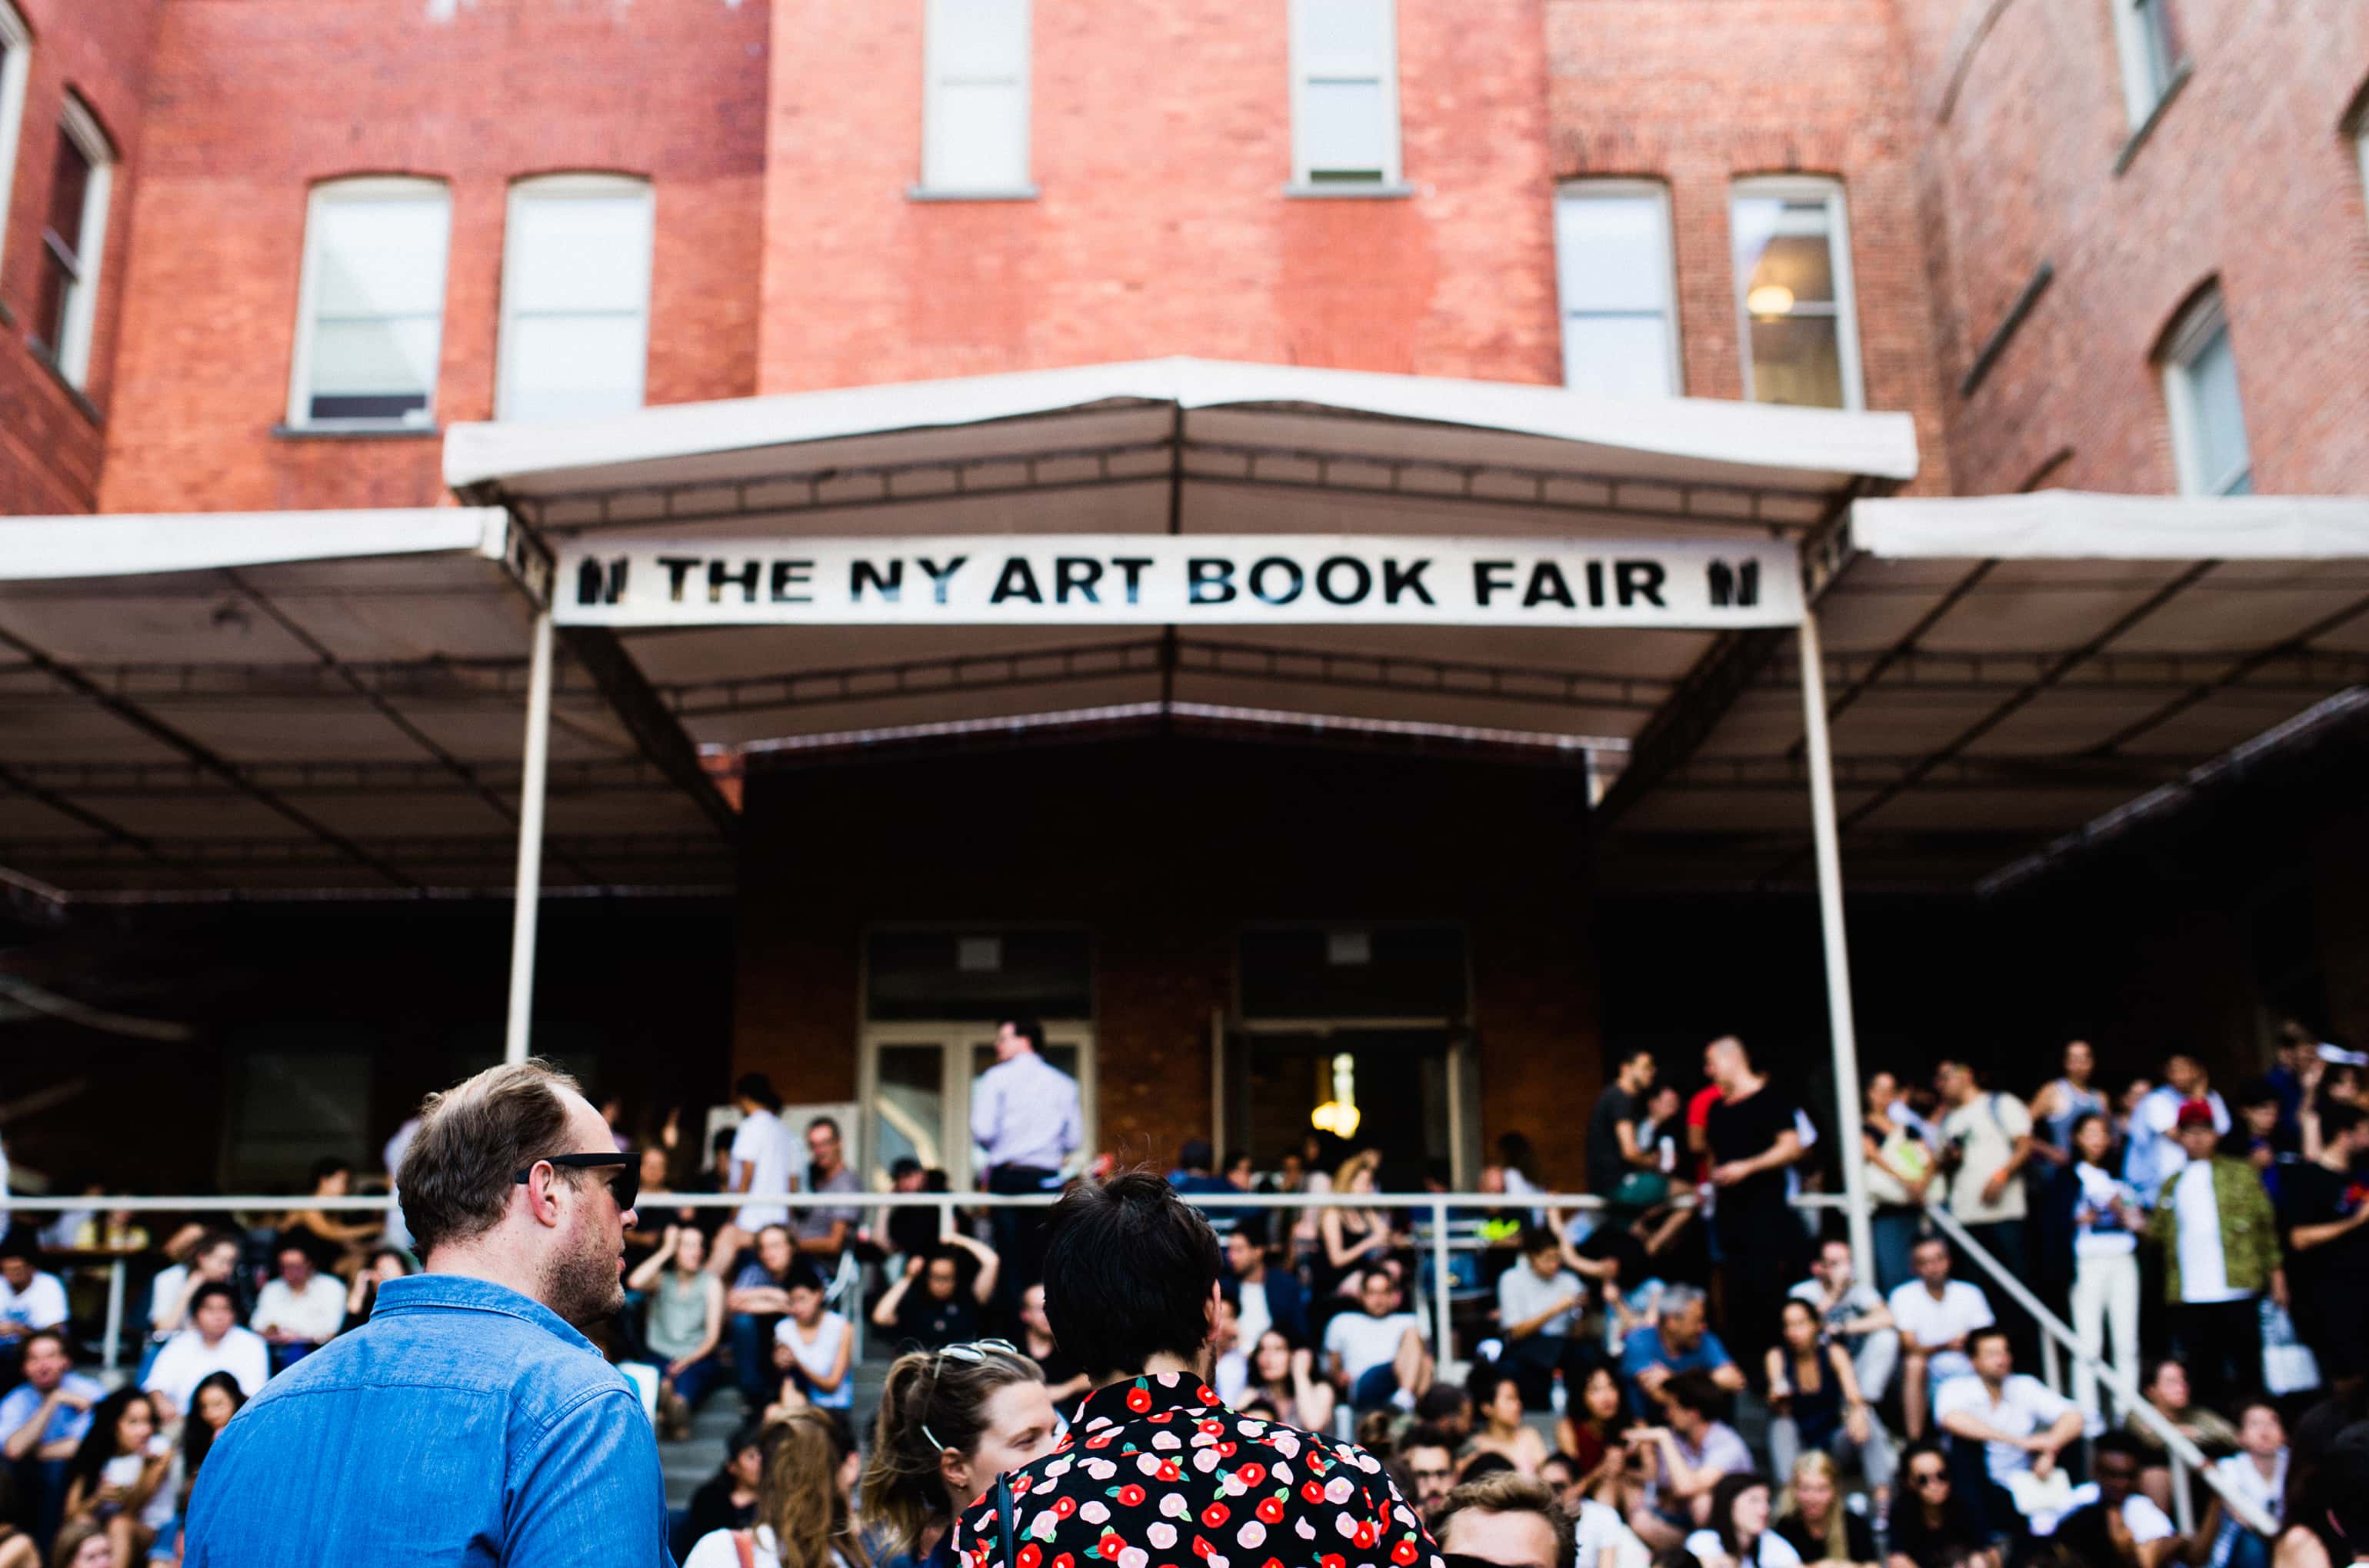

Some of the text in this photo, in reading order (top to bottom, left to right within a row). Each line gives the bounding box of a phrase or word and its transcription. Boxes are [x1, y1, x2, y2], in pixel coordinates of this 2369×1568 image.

[655, 555, 1667, 608] THE NY ART BOOK FAIR
